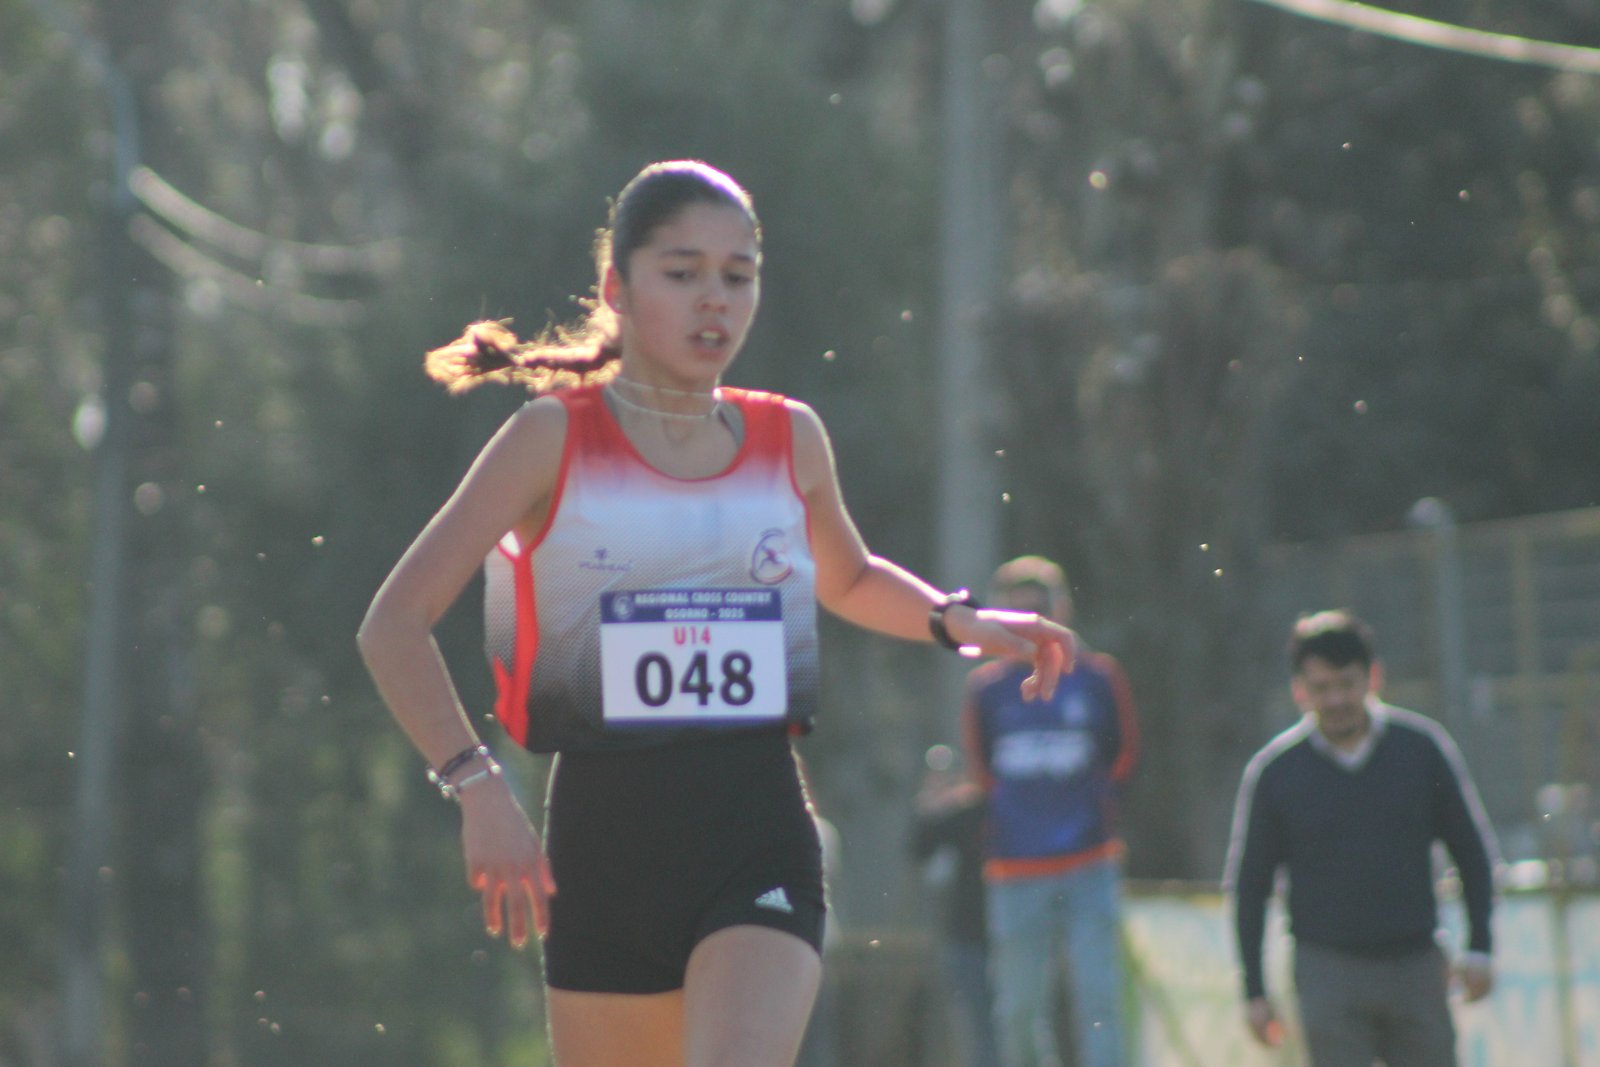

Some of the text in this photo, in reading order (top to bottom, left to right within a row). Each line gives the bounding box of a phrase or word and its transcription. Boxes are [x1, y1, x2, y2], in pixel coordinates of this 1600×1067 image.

[634, 591, 773, 605] REGIONAL CROSS COUNTRY
[673, 625, 712, 645] U14
[635, 651, 755, 707] 048
